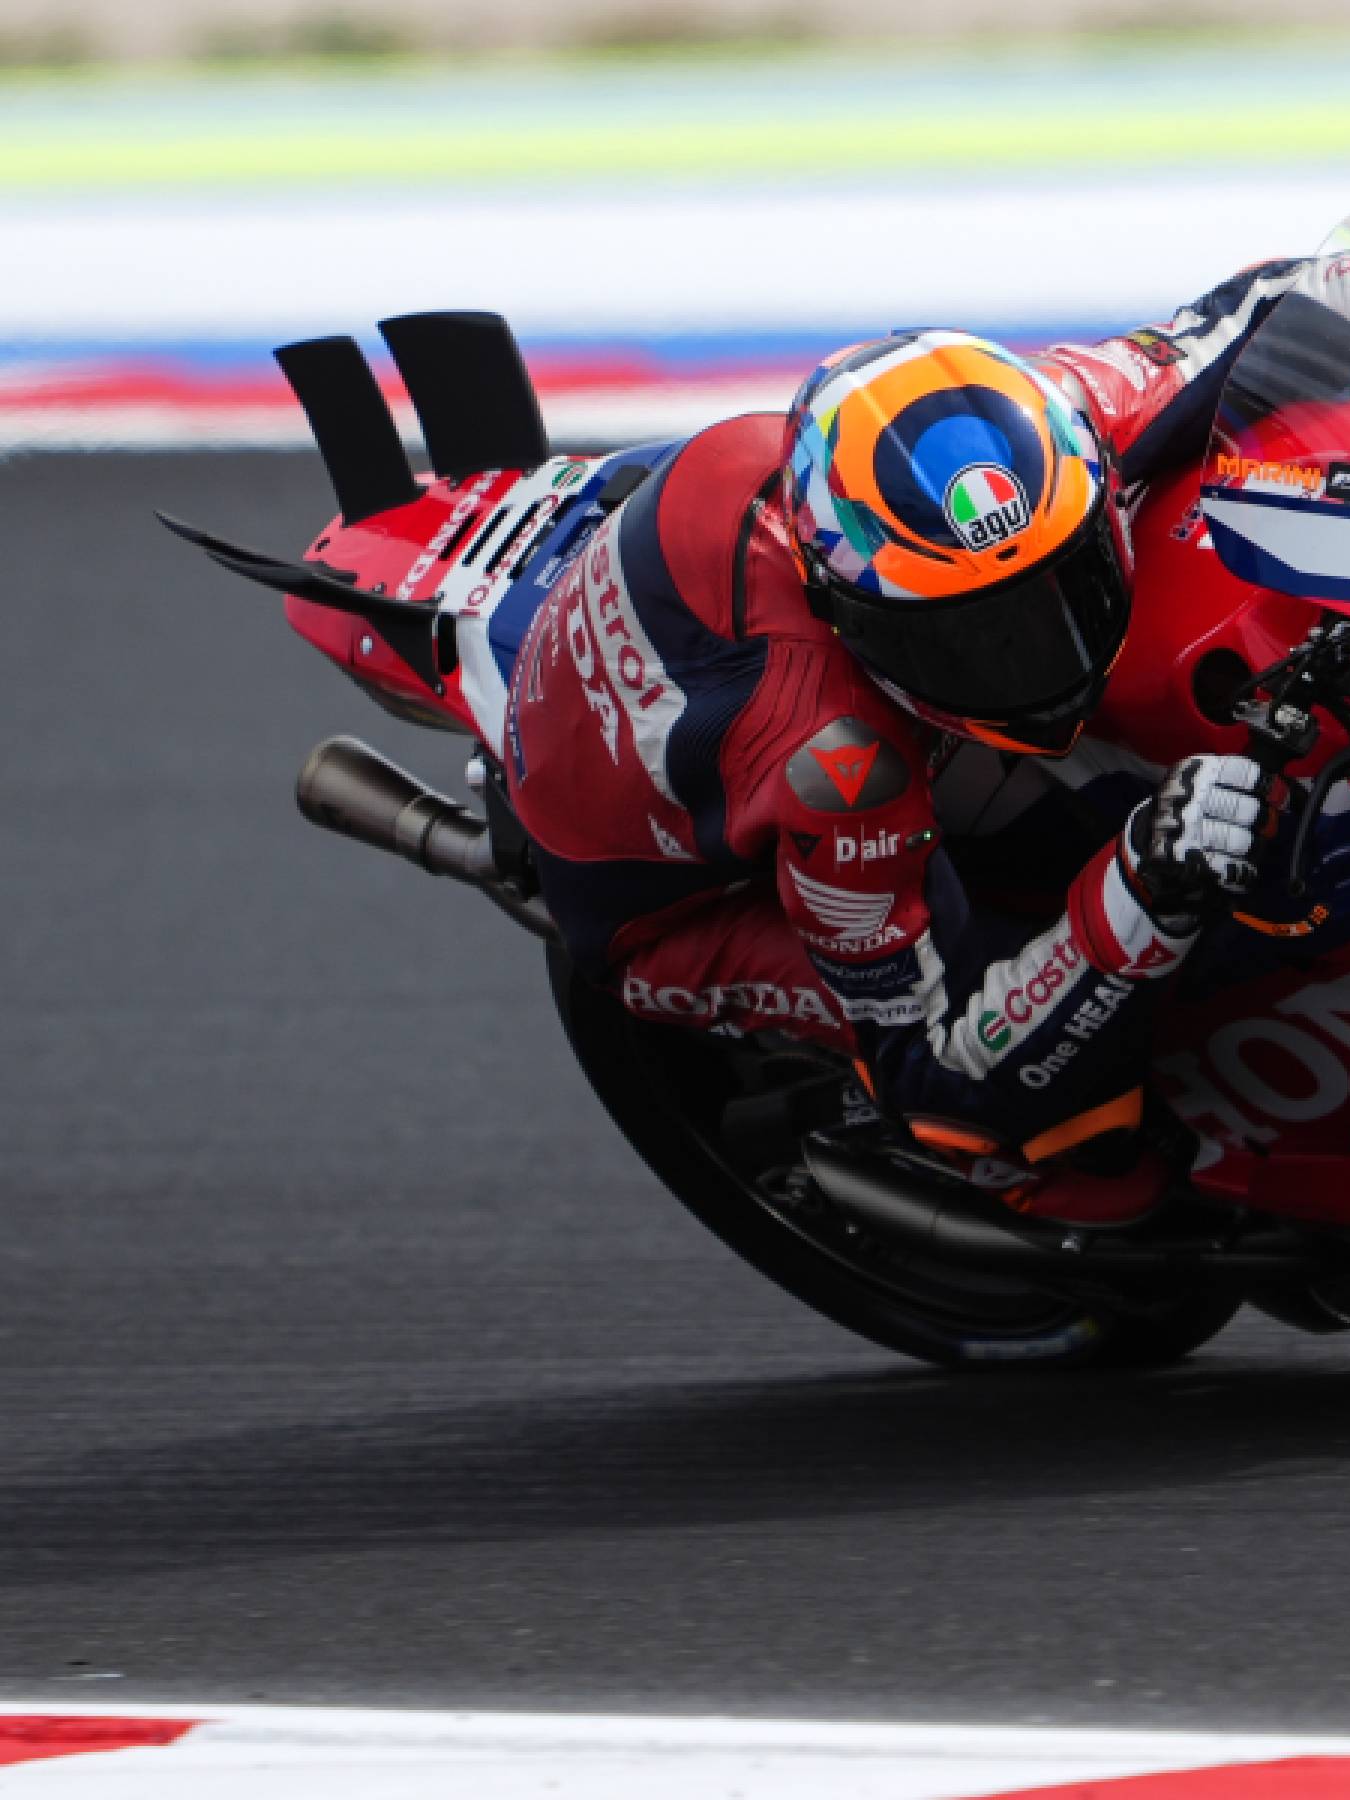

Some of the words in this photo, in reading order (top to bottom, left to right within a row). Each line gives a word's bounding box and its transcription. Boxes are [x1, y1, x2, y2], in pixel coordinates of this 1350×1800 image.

[1215, 453, 1322, 491] MARINI
[968, 499, 1019, 543] agv
[1018, 1038, 1080, 1091] One
